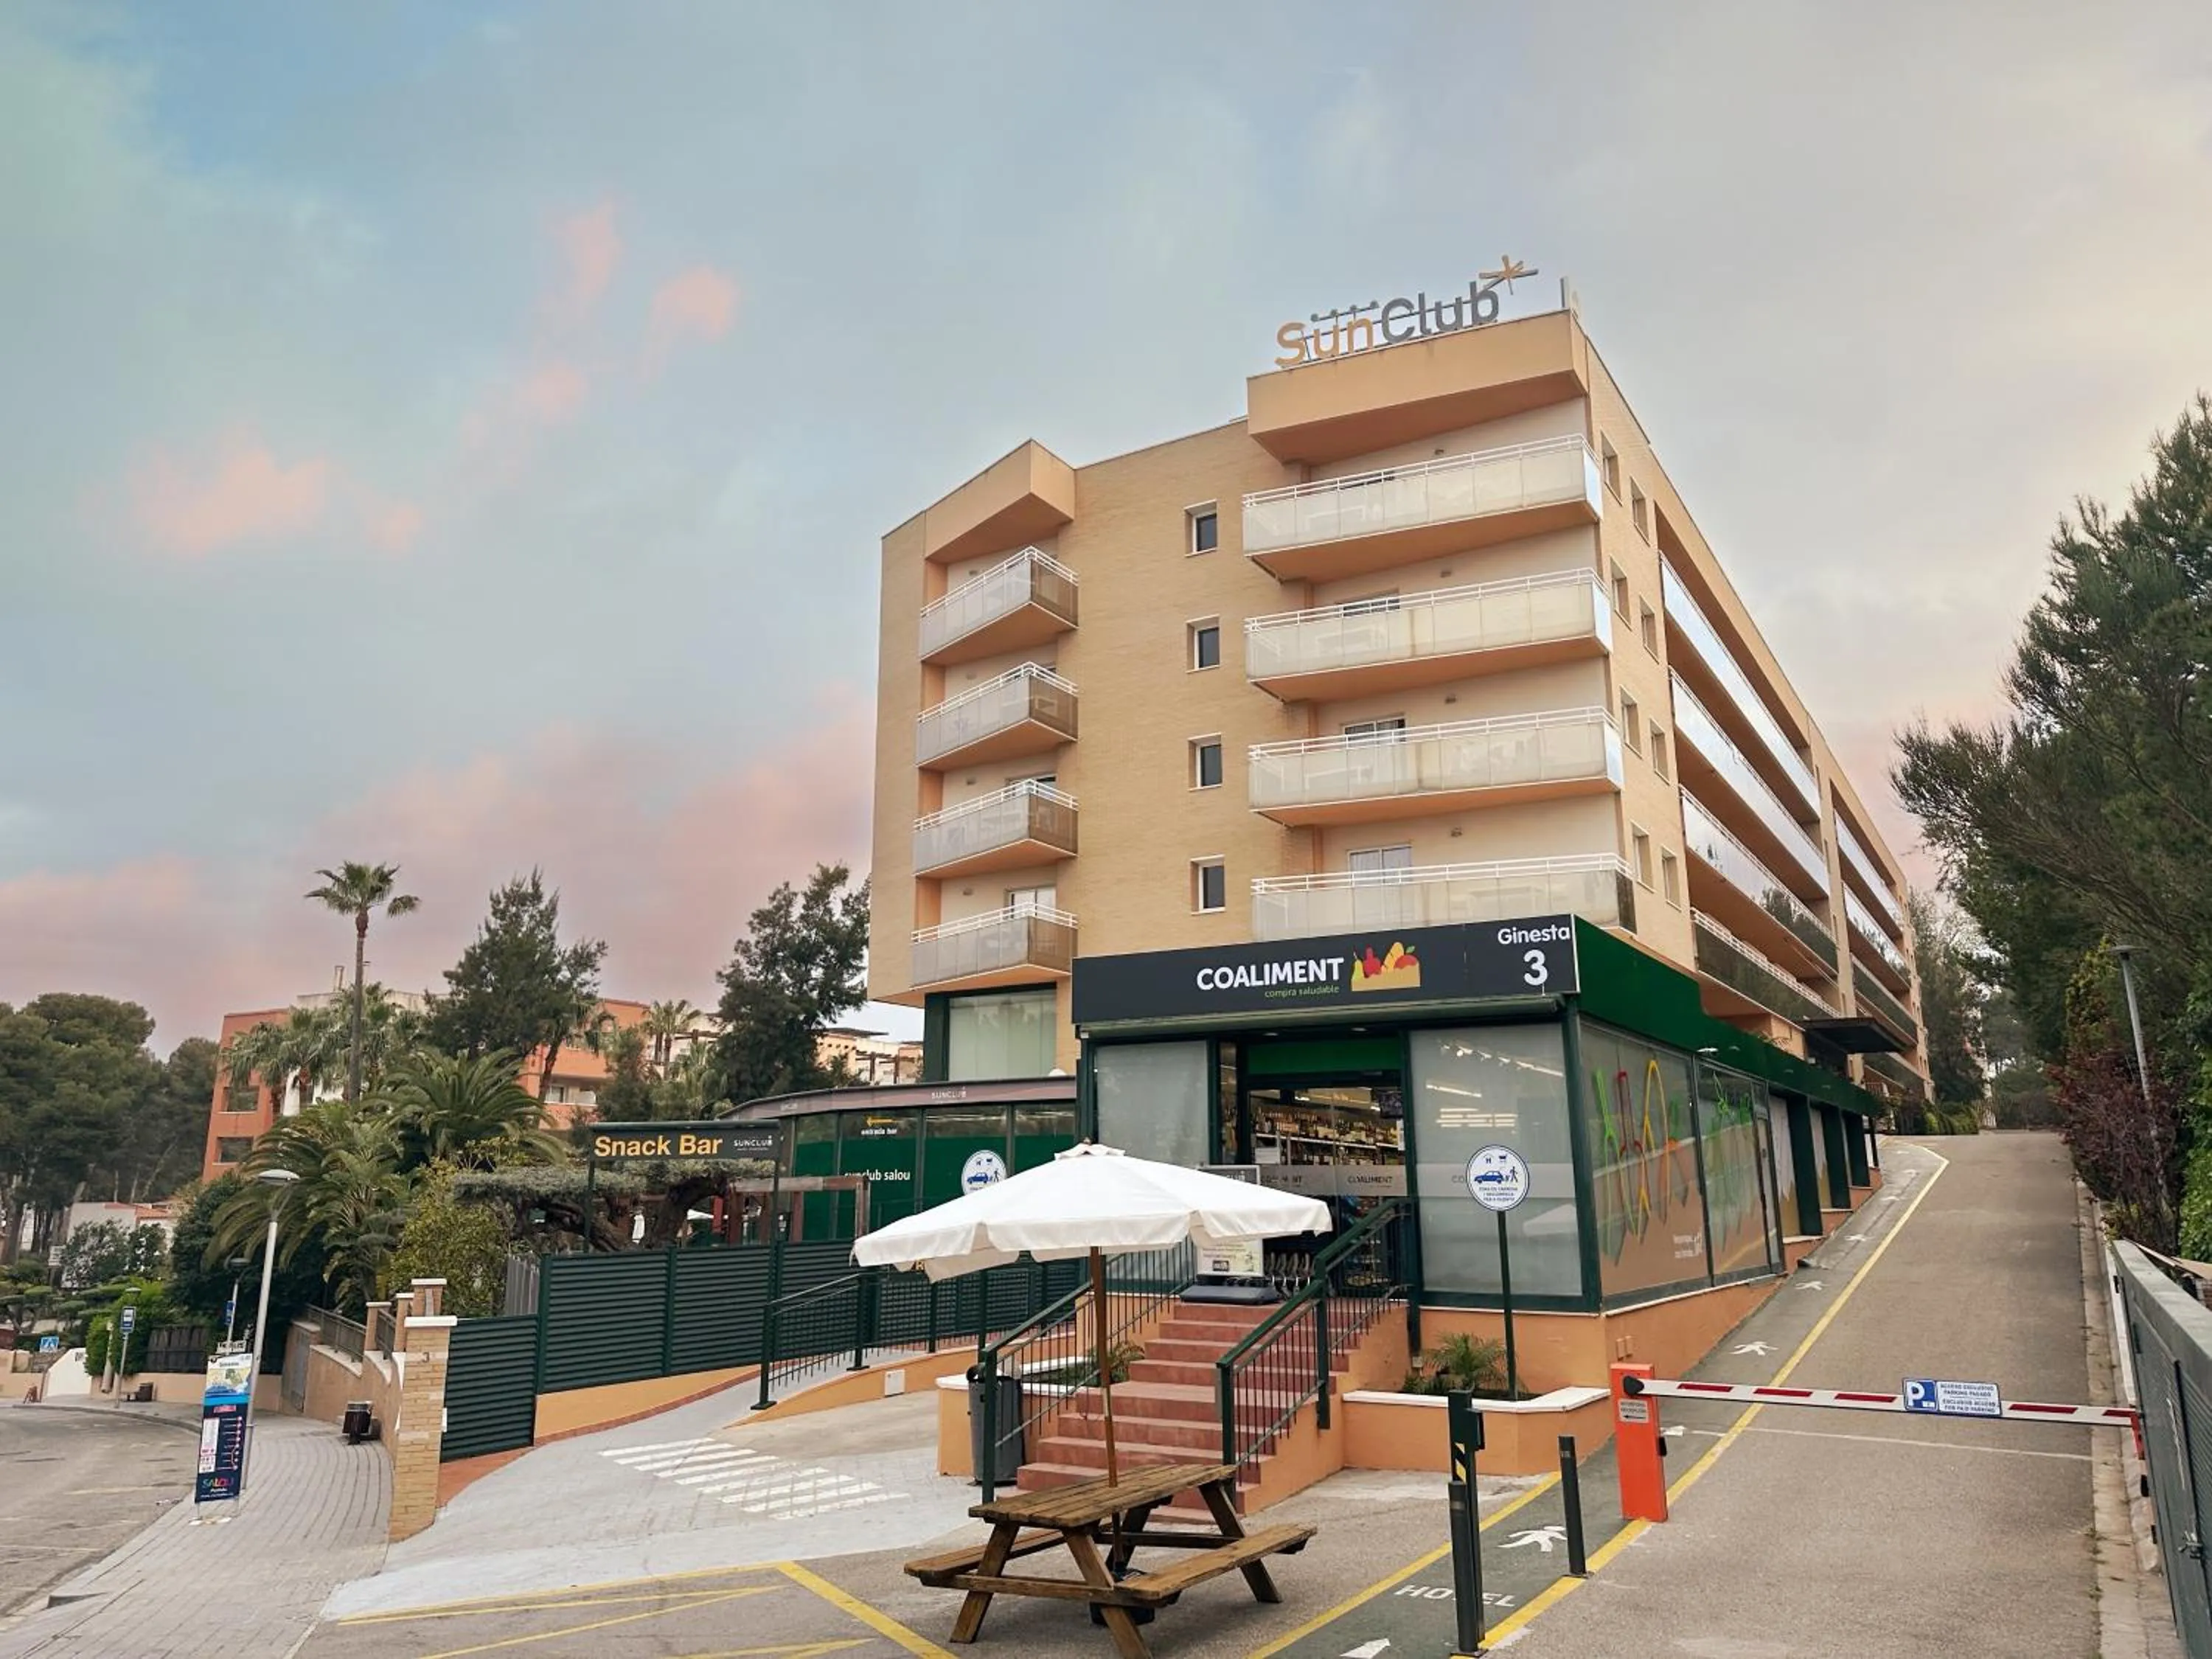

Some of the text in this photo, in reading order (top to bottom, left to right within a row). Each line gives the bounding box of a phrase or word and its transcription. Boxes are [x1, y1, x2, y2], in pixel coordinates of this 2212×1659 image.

[1275, 280, 1499, 368] SunClub
[1498, 924, 1571, 945] Ginesta
[1196, 957, 1344, 990] COALIMENT
[1523, 949, 1548, 986] 3
[1265, 985, 1340, 998] compra saludable
[594, 1134, 723, 1157] Snack Bar
[884, 1169, 911, 1181] salou
[1907, 1382, 1925, 1406] P
[1394, 1584, 1517, 1607] HOEL
